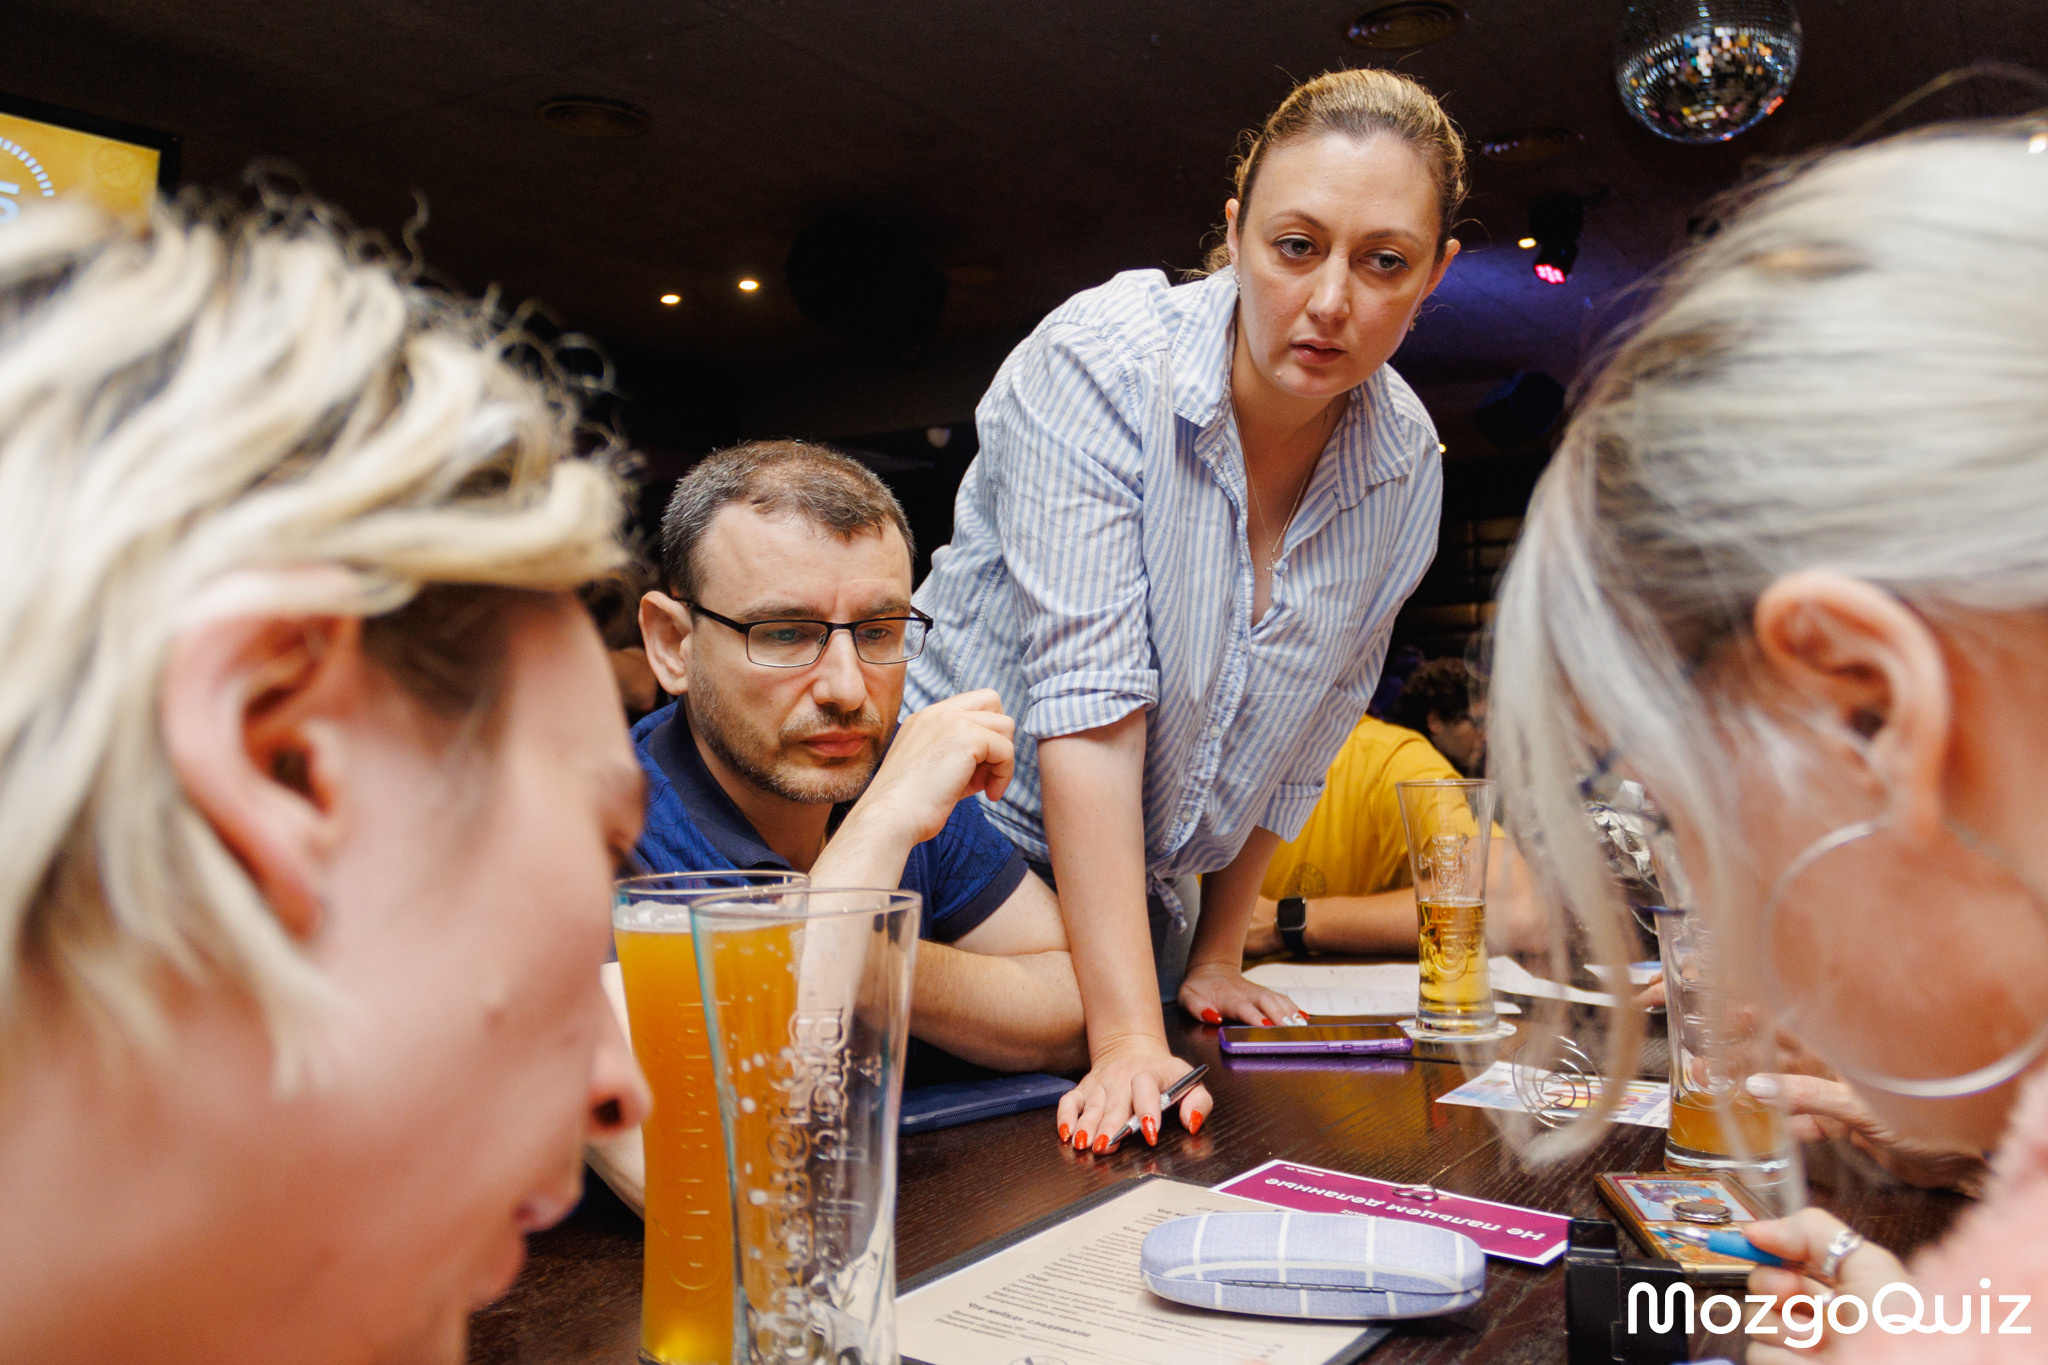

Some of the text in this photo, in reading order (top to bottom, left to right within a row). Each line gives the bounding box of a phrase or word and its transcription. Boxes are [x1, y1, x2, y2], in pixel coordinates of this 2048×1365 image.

[1263, 1177, 1546, 1243] Не пальцем деланные
